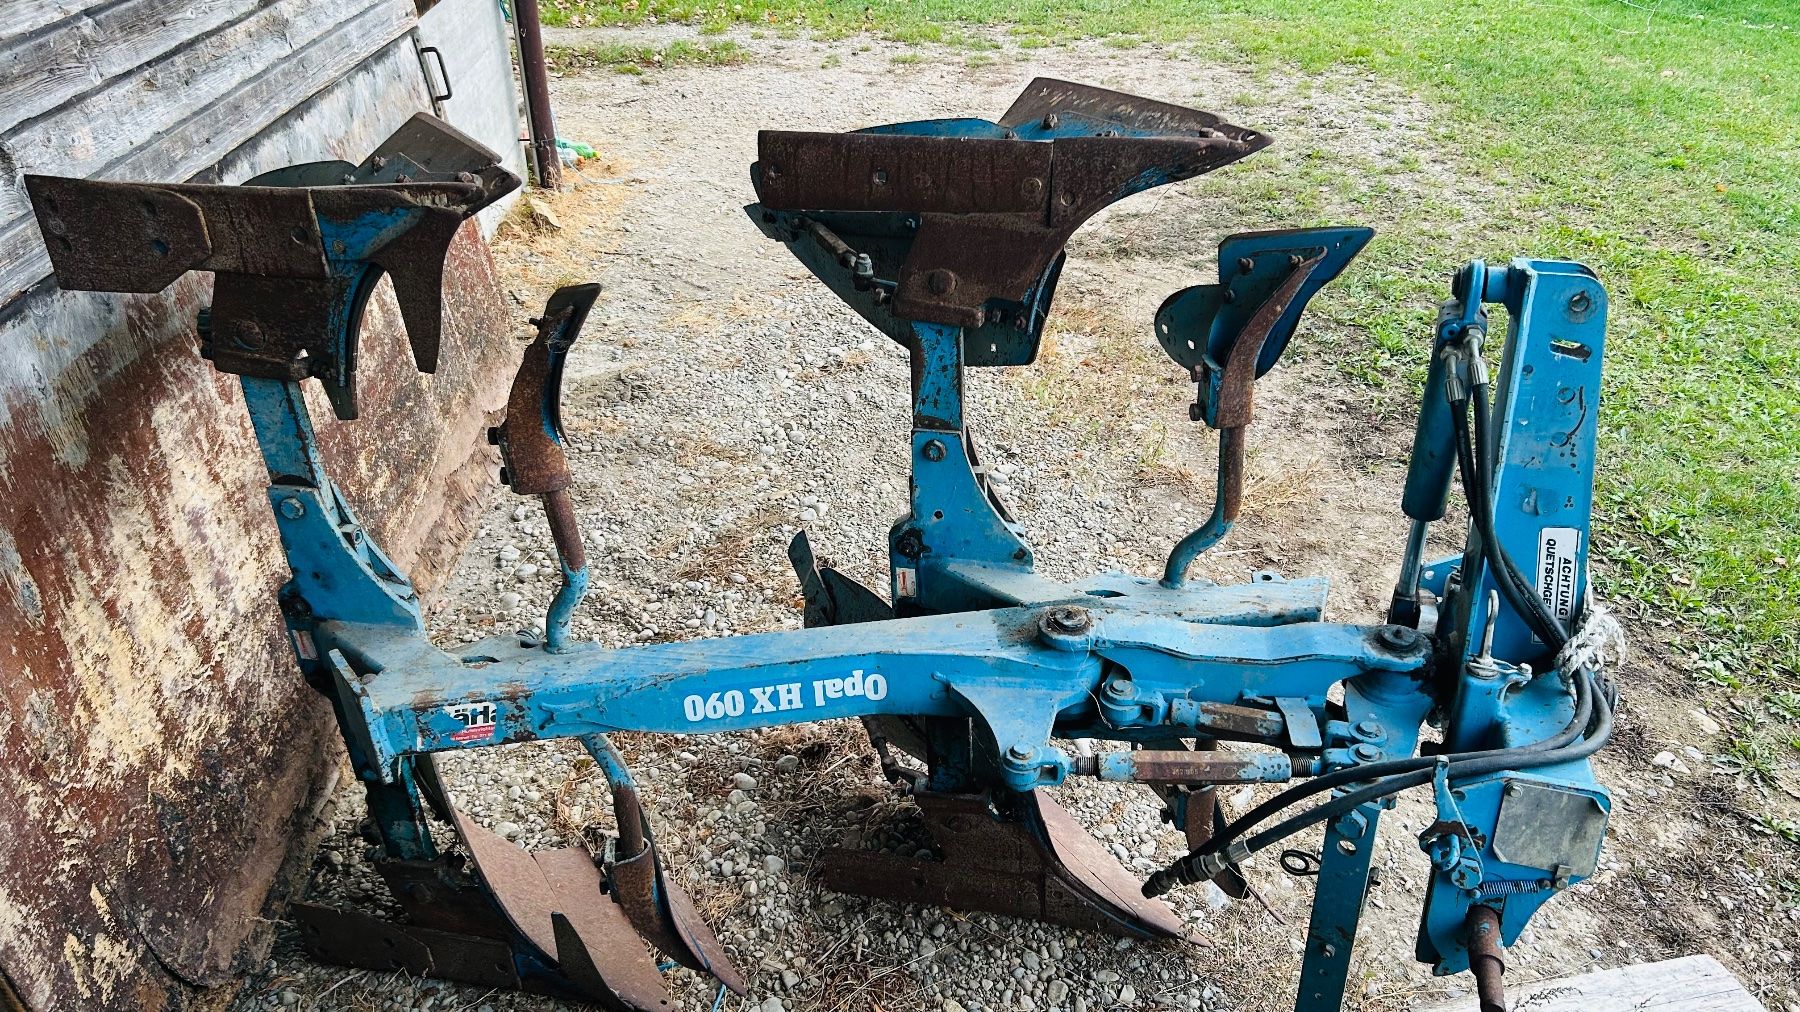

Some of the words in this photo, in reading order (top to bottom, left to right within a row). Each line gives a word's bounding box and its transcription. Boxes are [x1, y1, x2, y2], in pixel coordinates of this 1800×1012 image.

[1542, 538, 1557, 609] QUETSCHGE
[1558, 557, 1573, 622] ACHTUNG!
[683, 689, 745, 722] 090
[749, 682, 804, 714] HX
[812, 669, 888, 707] Opal
